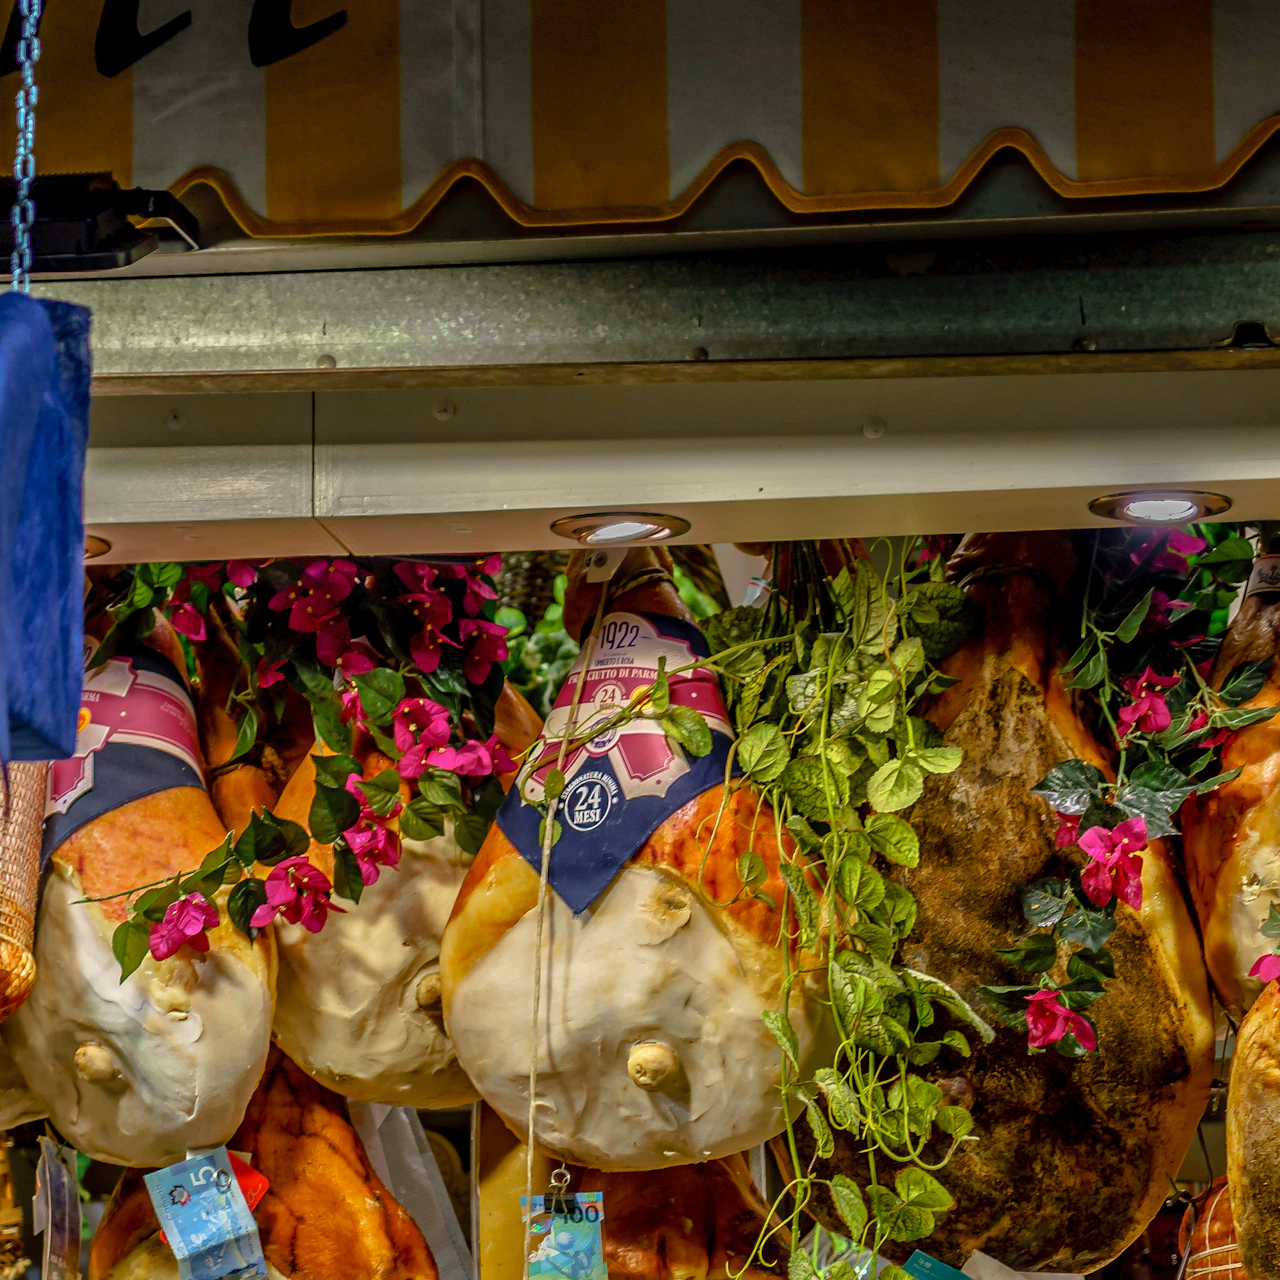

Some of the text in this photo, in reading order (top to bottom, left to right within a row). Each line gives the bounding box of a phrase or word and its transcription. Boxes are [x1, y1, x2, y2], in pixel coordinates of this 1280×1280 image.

[600, 621, 640, 650] 1922
[594, 658, 614, 667] UMBERTO
[621, 656, 634, 665] ROSA
[618, 668, 629, 678] DI
[631, 669, 659, 680] PARM
[600, 688, 616, 702] 24
[573, 784, 602, 811] 24
[573, 808, 601, 825] MESI
[189, 1165, 217, 1187] 5
[156, 1183, 174, 1222] Canada
